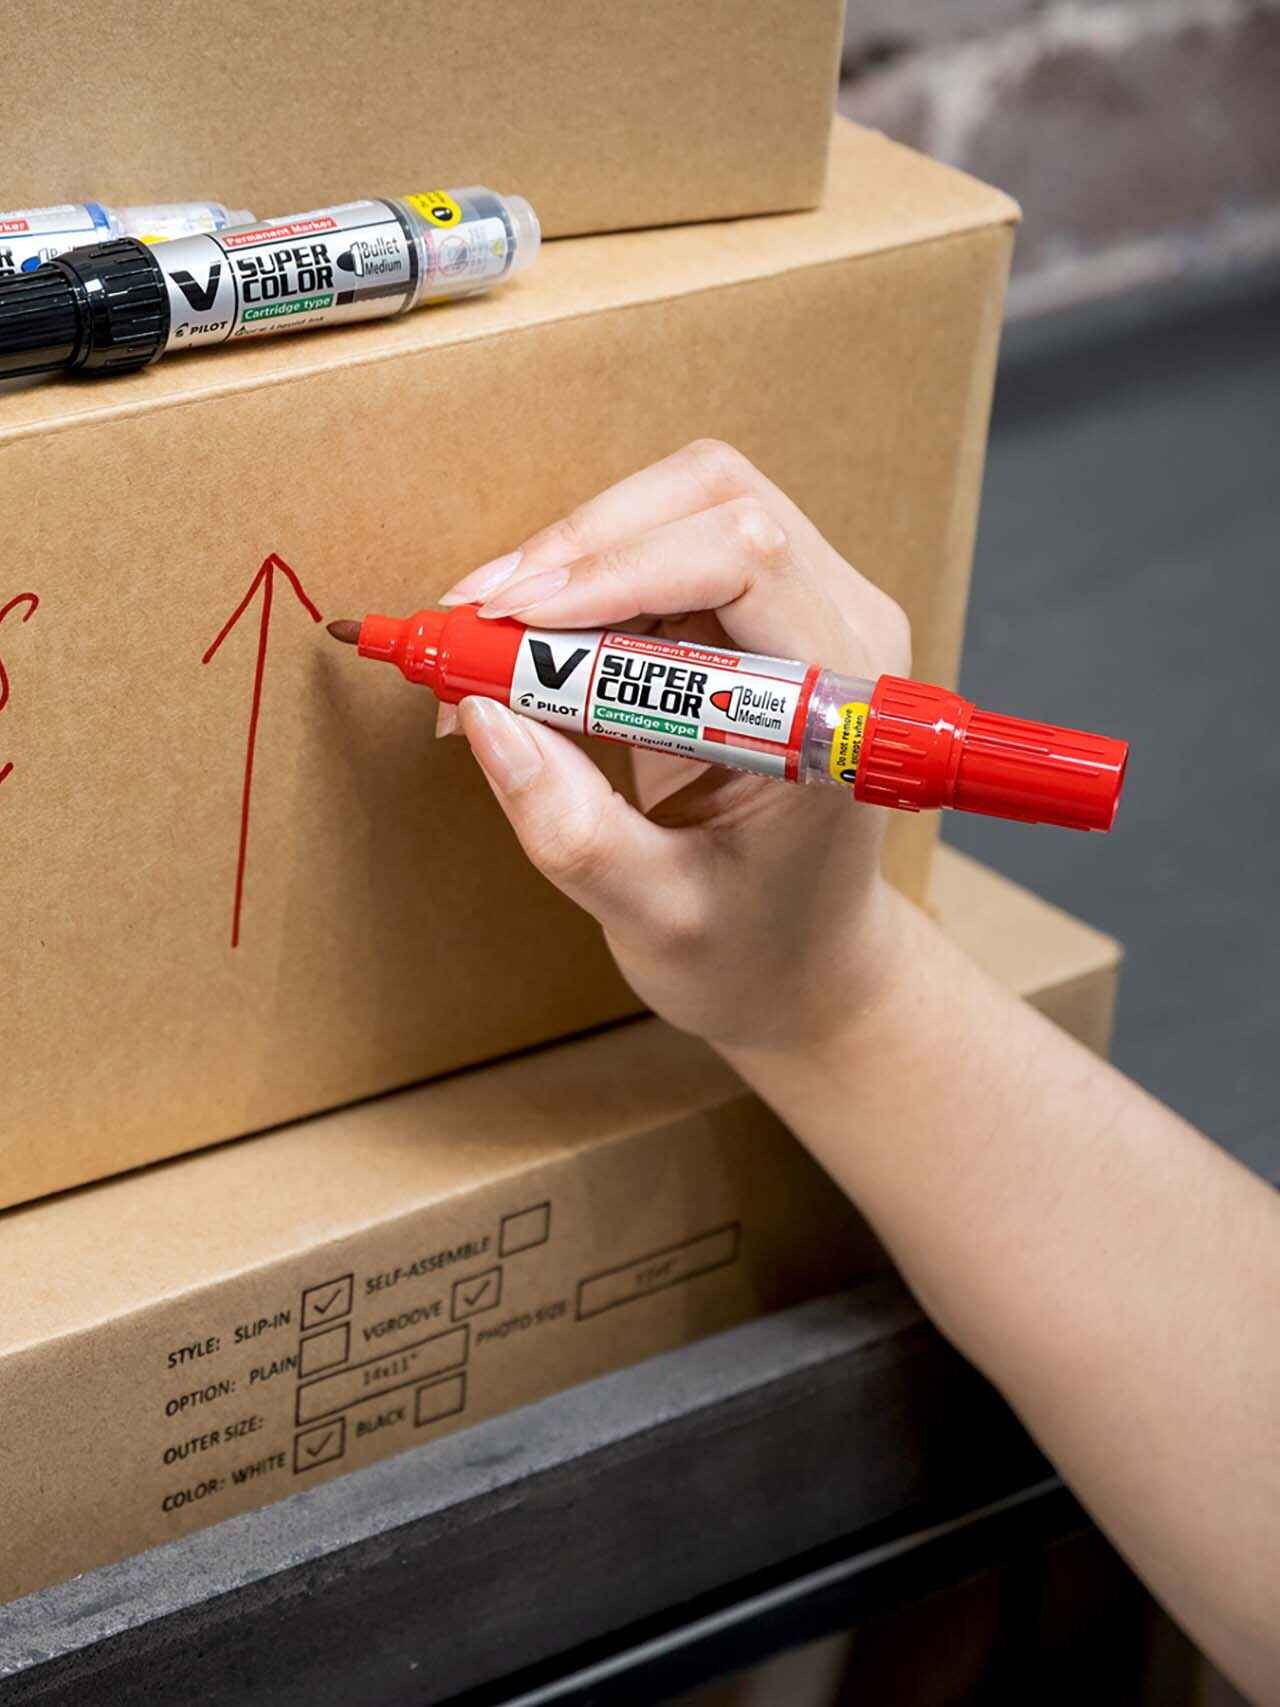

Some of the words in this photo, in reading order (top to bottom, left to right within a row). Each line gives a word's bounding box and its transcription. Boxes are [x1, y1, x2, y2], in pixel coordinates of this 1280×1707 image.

[227, 227, 289, 247] Permanent
[292, 218, 334, 235] Marker
[235, 241, 332, 280] SUPER
[362, 238, 402, 260] Bullet
[365, 259, 403, 276] Medium
[169, 259, 221, 312] V
[243, 265, 335, 304] COLOR
[244, 302, 301, 321] Cartridge
[304, 296, 332, 313] type
[190, 320, 228, 336] PILOT
[528, 638, 592, 691] V
[613, 636, 685, 657] Permanent
[688, 649, 738, 667] Marker
[601, 654, 709, 695] SUPER
[536, 701, 579, 717] PILOT
[597, 677, 703, 719] COLOR
[741, 687, 787, 714] Bullet
[596, 707, 660, 729] Cartridge
[664, 721, 696, 737] type
[738, 709, 783, 731] Medium
[843, 708, 853, 741] remove
[632, 734, 673, 748] Liquid
[676, 743, 697, 754] Ink
[840, 742, 848, 756] not
[837, 756, 847, 767] Do
[167, 1336, 221, 1370] STYLE:
[233, 1309, 291, 1344] SLIP-IN
[365, 1236, 491, 1296] SELF-ASSEMBLE
[165, 1380, 237, 1417] OPTION:
[249, 1354, 298, 1385] PLAIN
[363, 1300, 443, 1342] VGROOVE
[163, 1430, 220, 1465] OUTER
[223, 1415, 264, 1442] SIZE:
[161, 1478, 226, 1513] COLOR:
[231, 1451, 287, 1485] WHITE
[355, 1404, 407, 1438] BLACK
